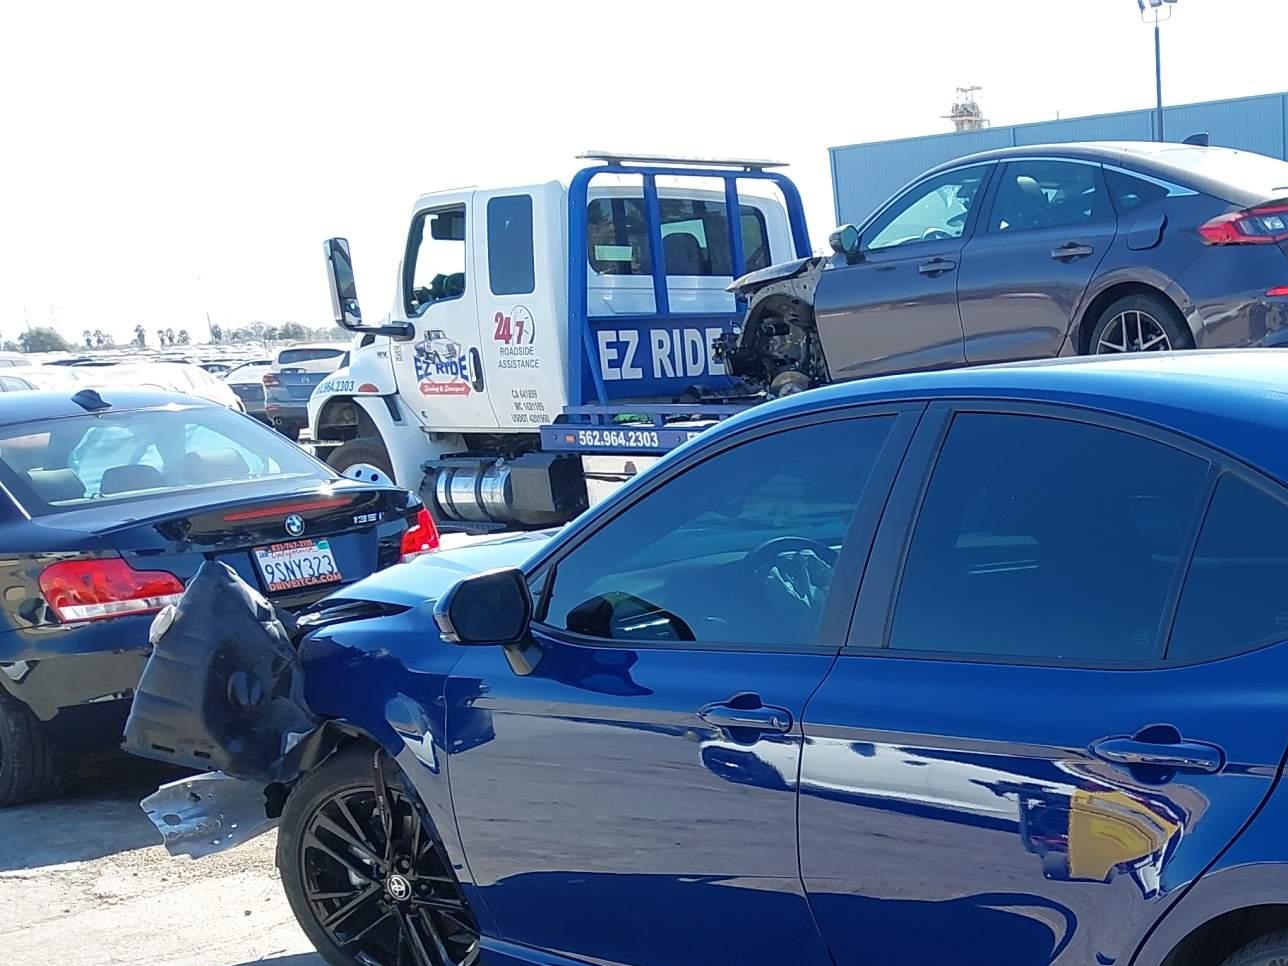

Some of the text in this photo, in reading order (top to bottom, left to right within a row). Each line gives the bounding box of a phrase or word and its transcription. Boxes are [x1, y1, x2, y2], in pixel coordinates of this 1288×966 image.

[499, 346, 535, 357] ROADSIDE
[597, 327, 727, 381] EZ RIDE
[414, 355, 469, 382] EZ RIDE
[498, 360, 540, 369] ASSISTANCE
[578, 431, 659, 447] 562.964.2303
[265, 554, 336, 584] 9SNY323
[269, 572, 342, 592] DRIVEITCA.COM
